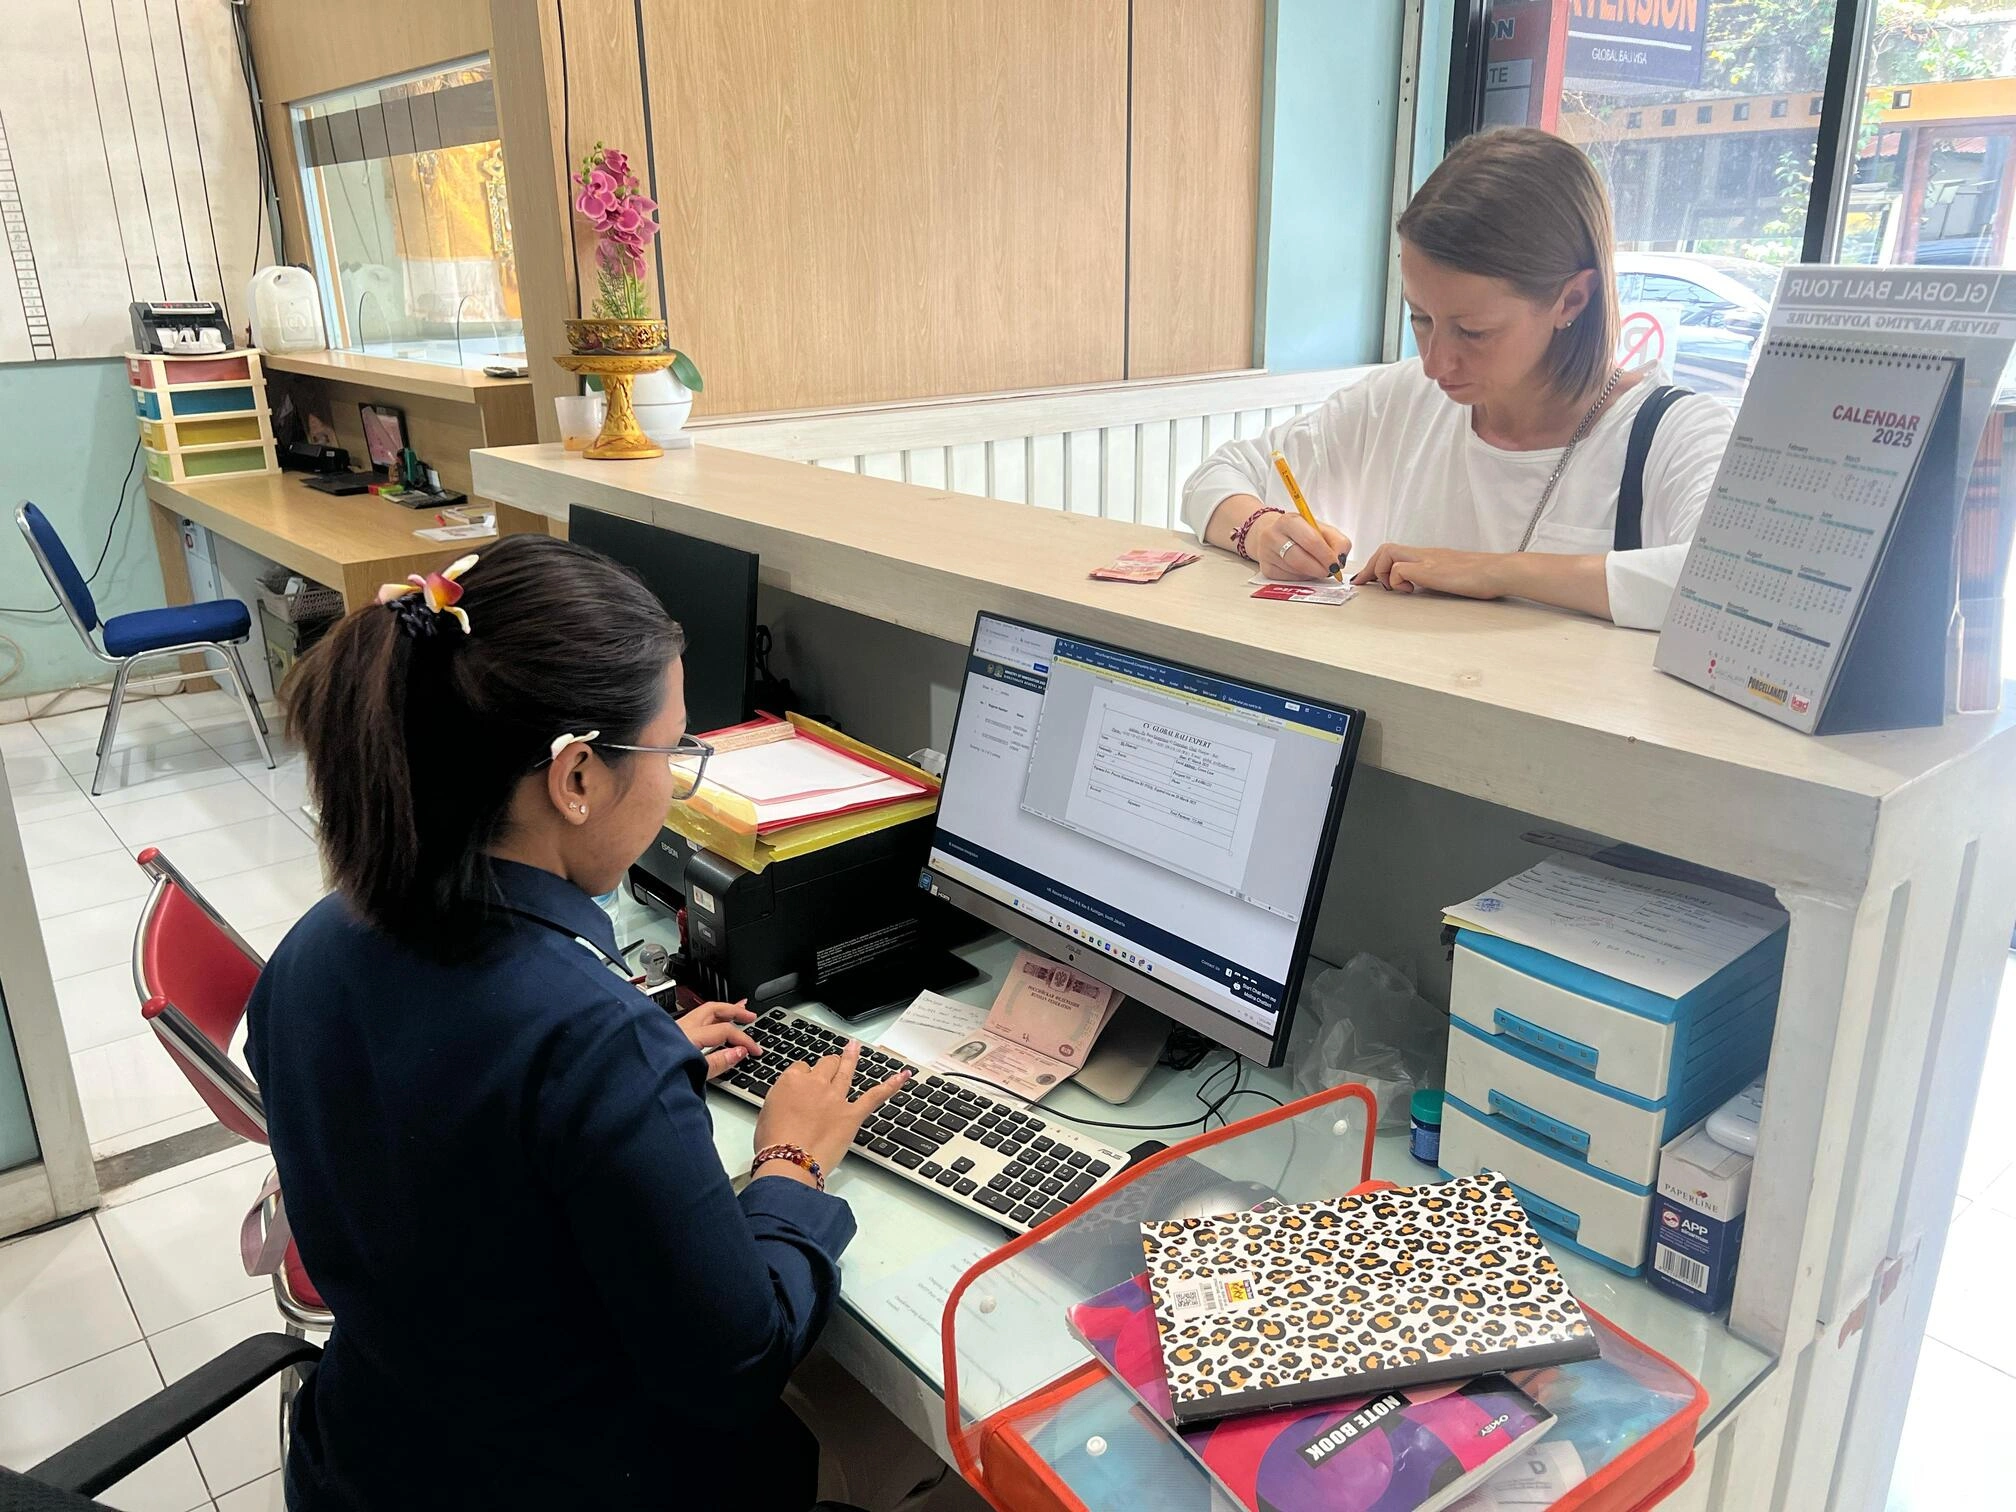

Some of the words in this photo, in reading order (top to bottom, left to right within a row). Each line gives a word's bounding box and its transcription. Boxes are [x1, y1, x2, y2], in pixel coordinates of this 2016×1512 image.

[1833, 405, 1920, 431] CALENDAR
[1872, 428, 1914, 448] 2025
[661, 841, 679, 859] EPSON
[1665, 1183, 1719, 1213] PAPERLINE
[1681, 1219, 1709, 1236] APP
[1353, 1395, 1401, 1429] NOTE
[1305, 1421, 1358, 1461] BOOK
